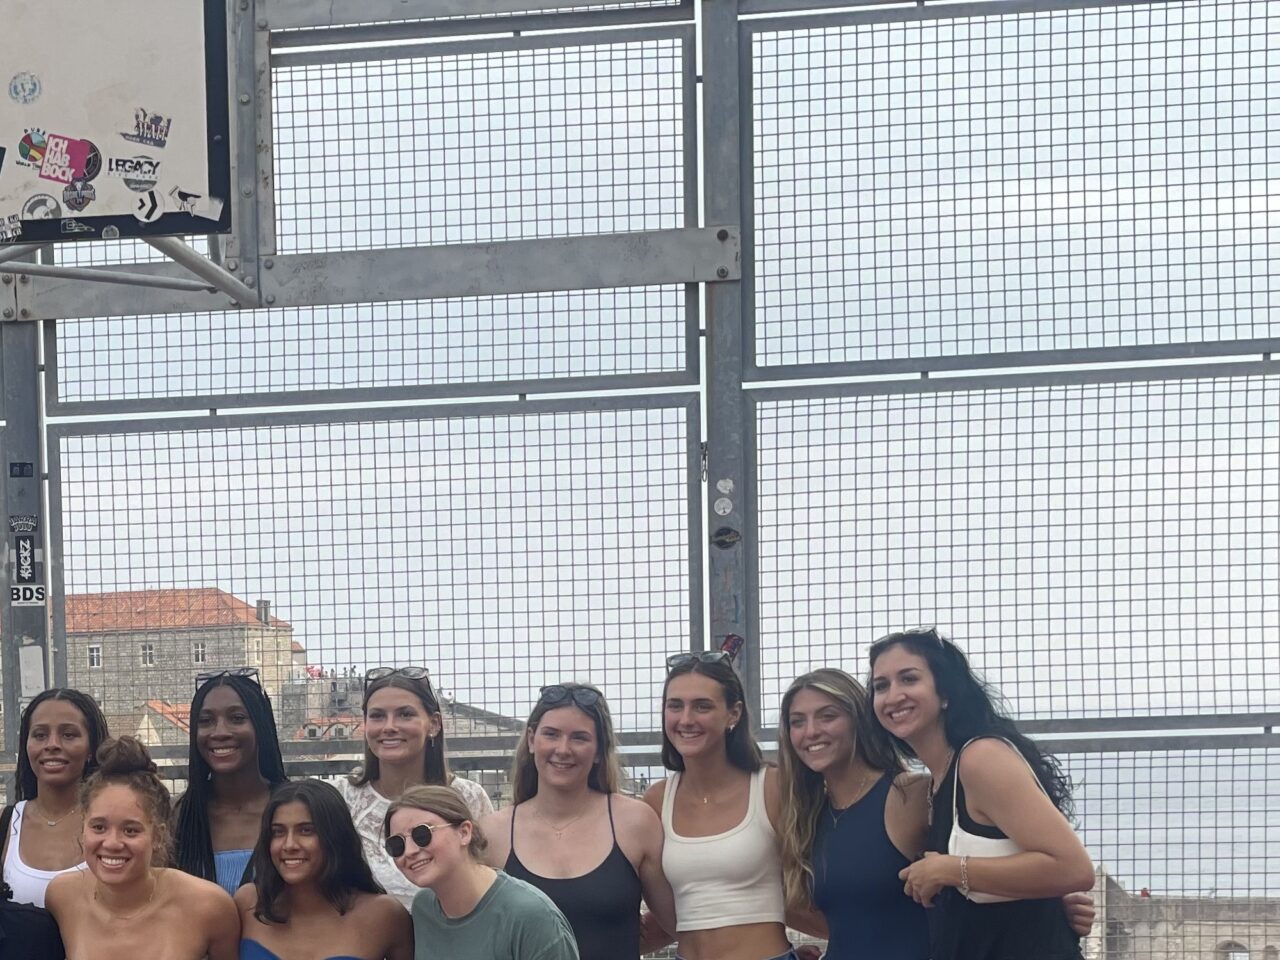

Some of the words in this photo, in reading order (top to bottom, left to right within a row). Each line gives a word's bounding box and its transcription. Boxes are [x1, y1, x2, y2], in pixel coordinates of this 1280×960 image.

[47, 136, 69, 153] ICH
[44, 150, 71, 167] HAB
[108, 158, 160, 175] LEGACY
[40, 163, 76, 182] BOCK
[11, 587, 45, 601] BDS
